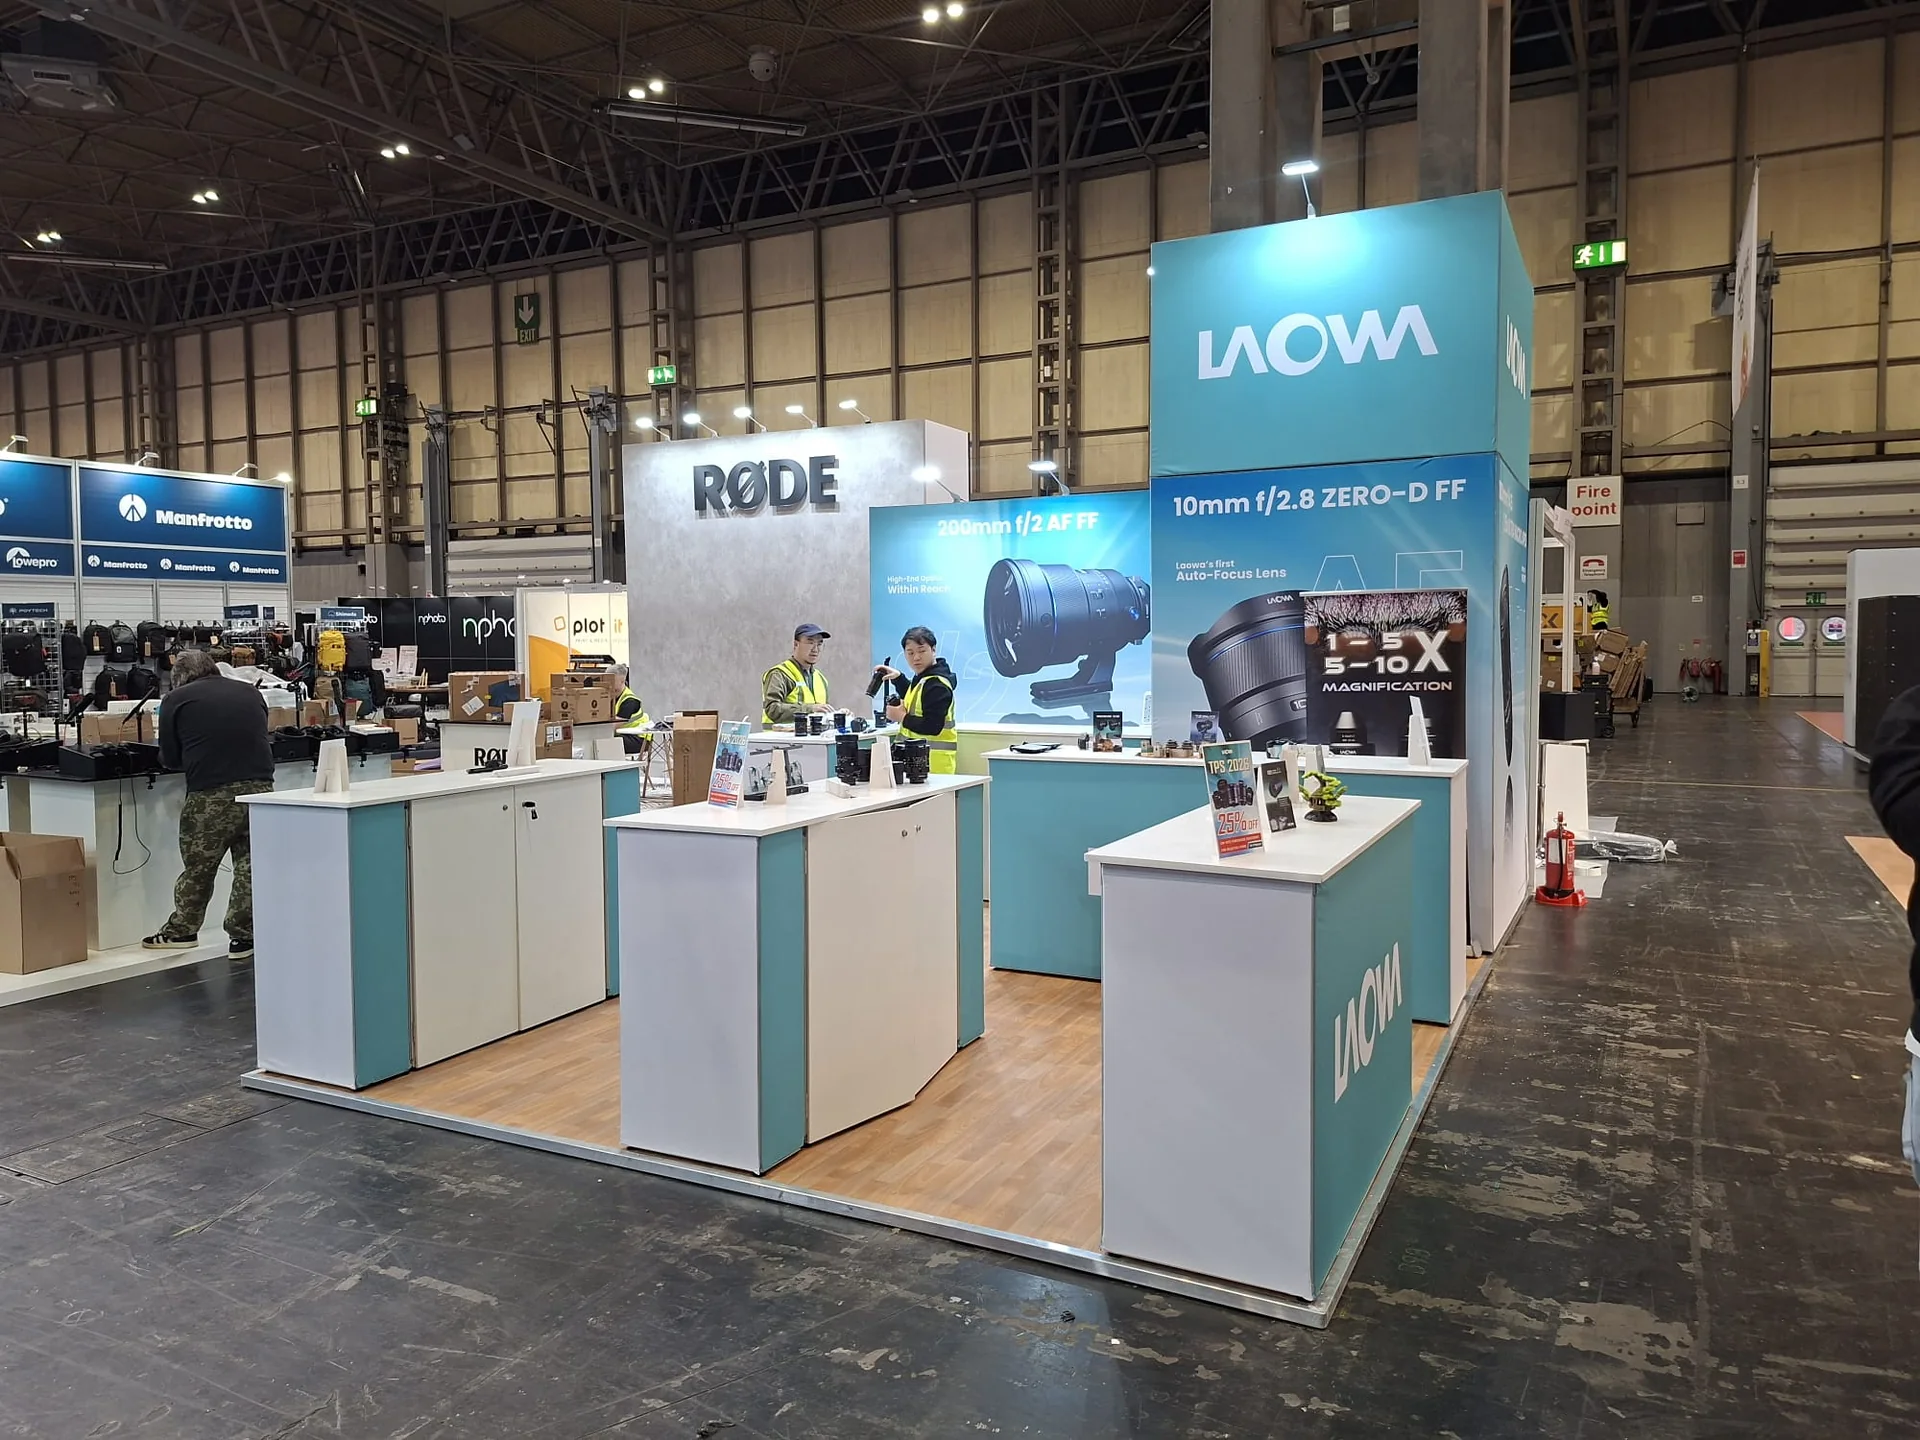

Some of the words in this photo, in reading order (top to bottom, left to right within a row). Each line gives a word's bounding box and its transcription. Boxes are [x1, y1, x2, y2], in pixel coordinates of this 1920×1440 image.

[520, 328, 536, 342] EXIT
[1198, 304, 1438, 380] LAOWA
[693, 455, 838, 511] RØDE
[1173, 496, 1250, 517] 10mm
[1256, 485, 1315, 516] f/2.8
[1321, 482, 1428, 508] ZERO-D
[1435, 479, 1467, 501] FF
[1576, 485, 1611, 498] Fire
[1572, 502, 1617, 516] point
[156, 510, 253, 531] Manfrotto
[938, 518, 1012, 537] 200mm
[1015, 511, 1043, 537] f/2
[1047, 514, 1073, 531] AF
[1076, 512, 1100, 530] FF
[13, 556, 58, 569] Lowepro
[103, 561, 148, 570] Manfrotto
[175, 564, 216, 572] Manfrotto
[1175, 560, 1214, 570] Laowa's
[1215, 559, 1236, 568] first
[242, 567, 280, 575] Manfrotto
[1175, 568, 1253, 582] Auto-Focus
[1256, 566, 1287, 579] Lens
[887, 584, 918, 594] Within
[573, 617, 605, 637] plot
[614, 618, 623, 633] it
[1322, 681, 1453, 692] MAGNIFICATION
[1208, 760, 1226, 774] TPS
[1217, 811, 1247, 836] 25%
